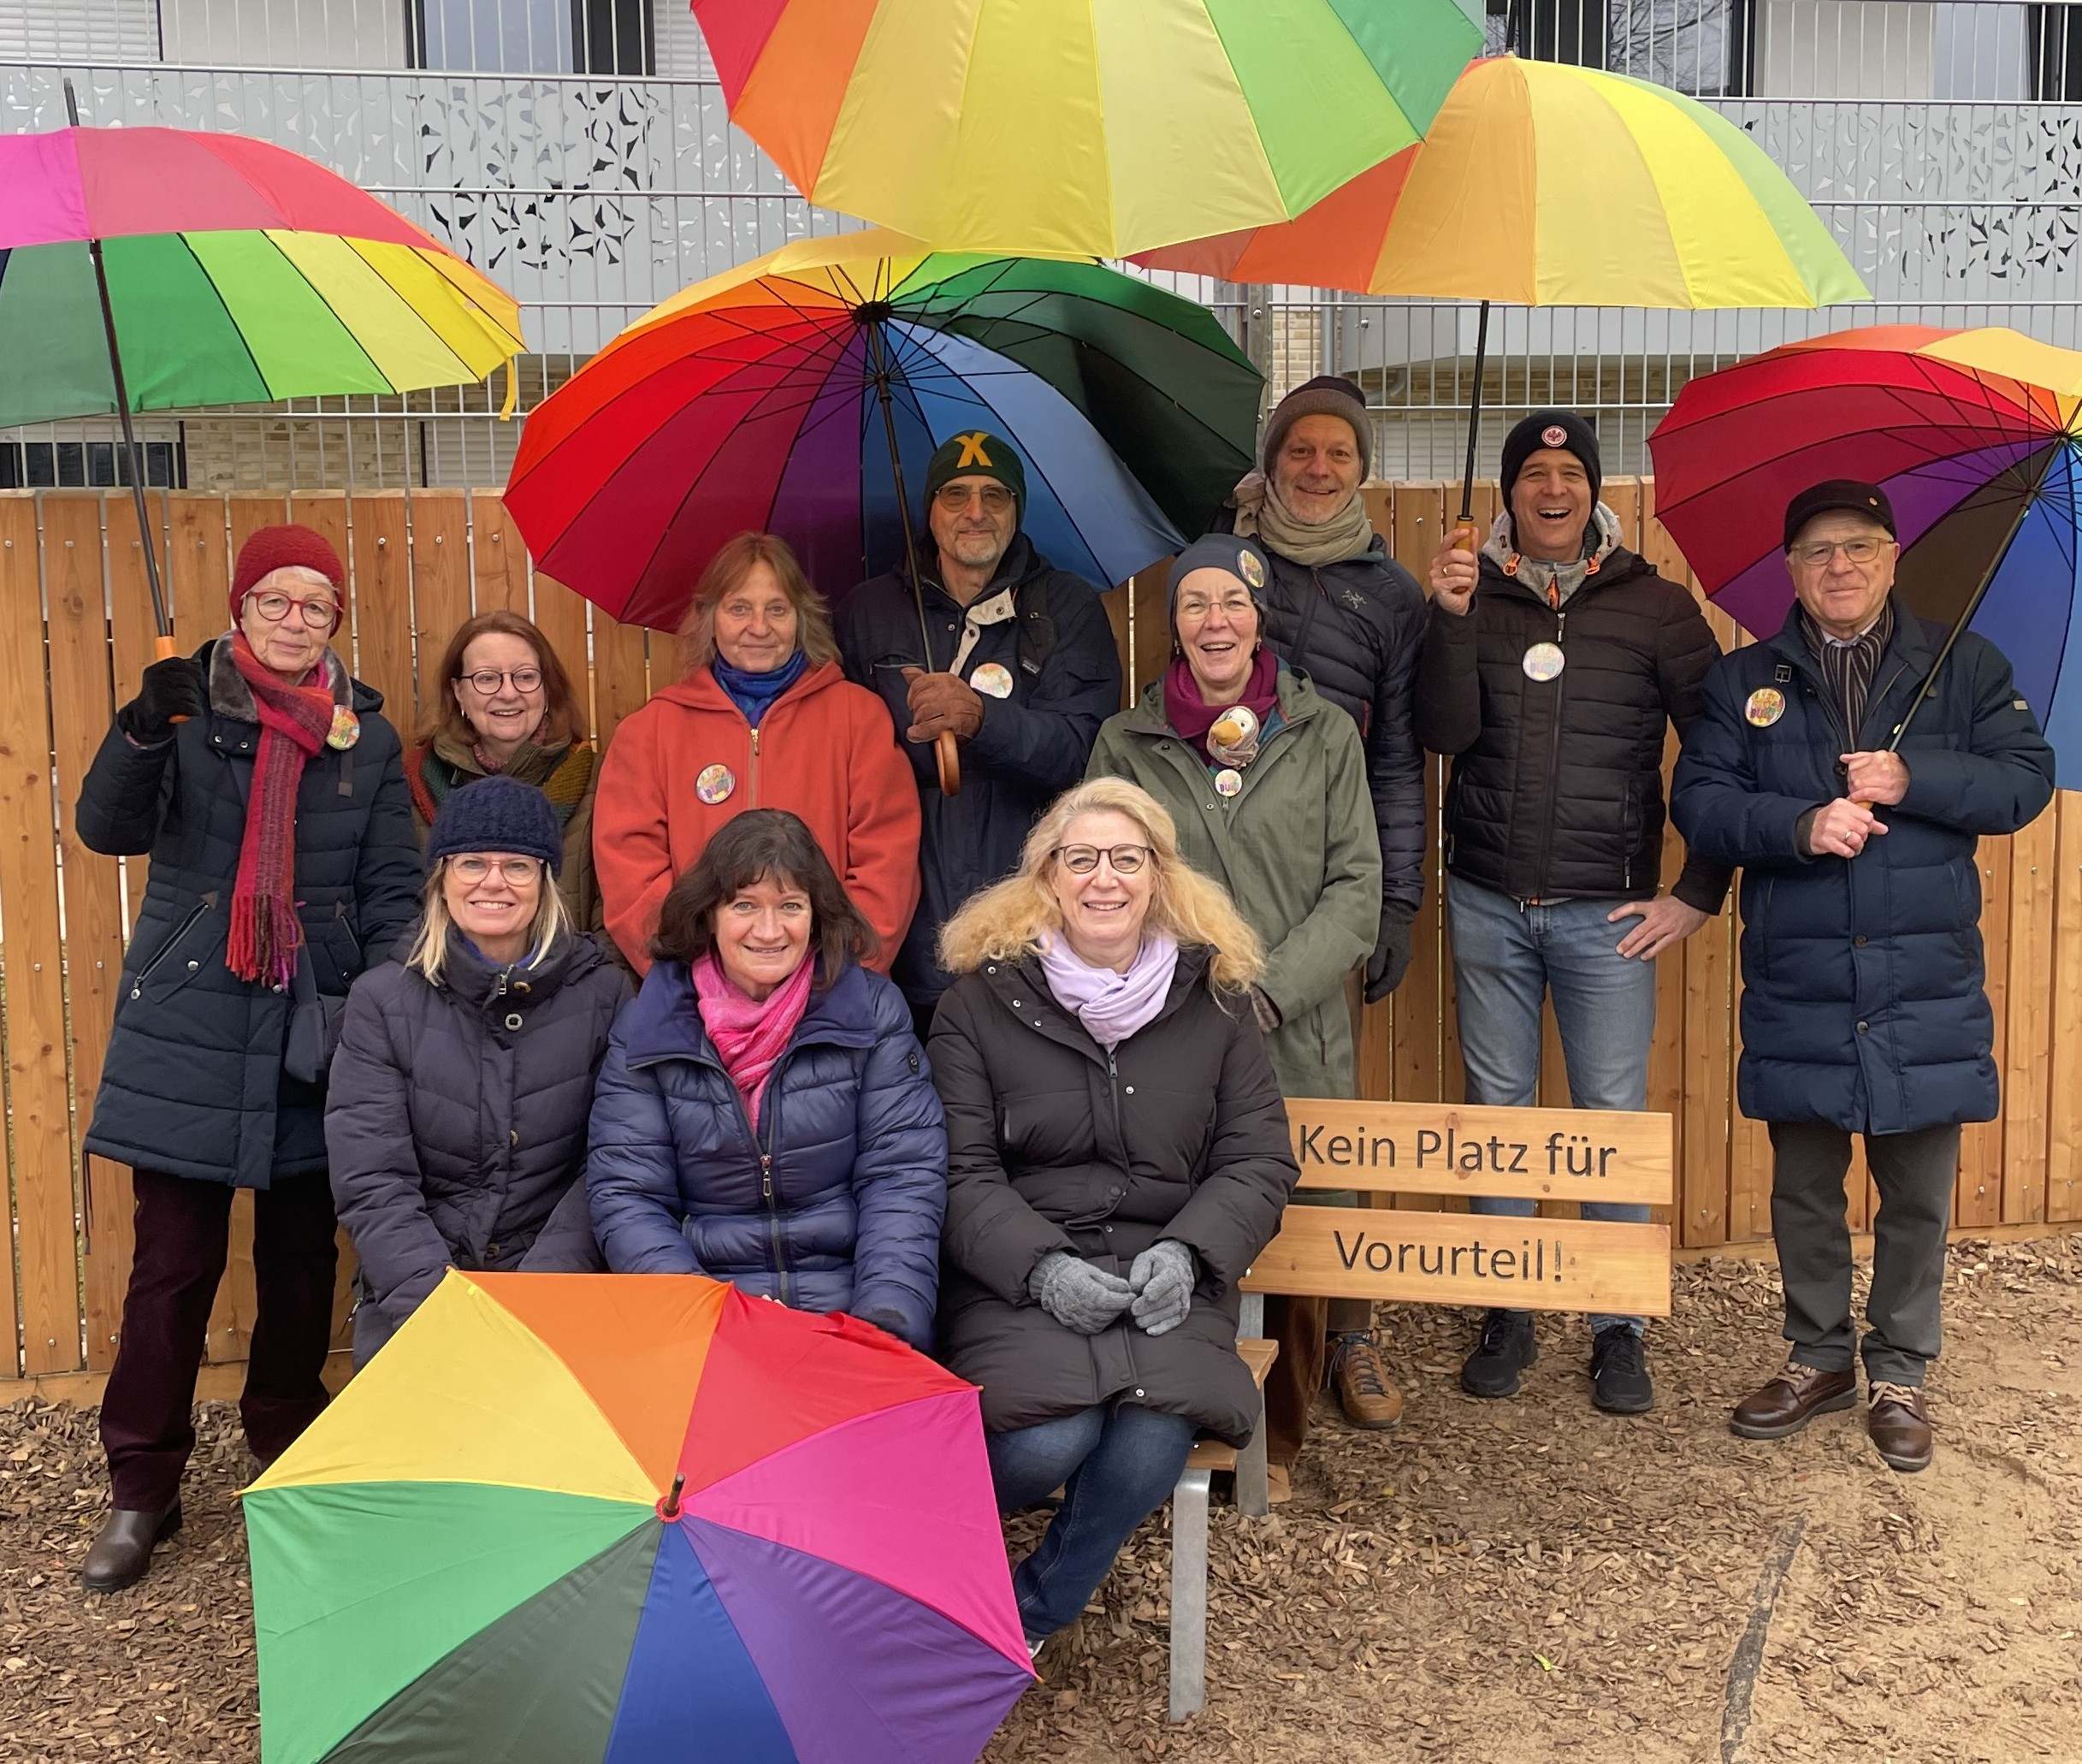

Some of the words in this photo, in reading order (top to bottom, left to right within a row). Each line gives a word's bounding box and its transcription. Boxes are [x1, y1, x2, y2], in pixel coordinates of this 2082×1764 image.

[954, 432, 993, 468] X
[1298, 1124, 1395, 1167] Kein
[1417, 1128, 1529, 1174] Platz
[1545, 1132, 1618, 1177] für
[1334, 1230, 1563, 1282] Vorurteil!
